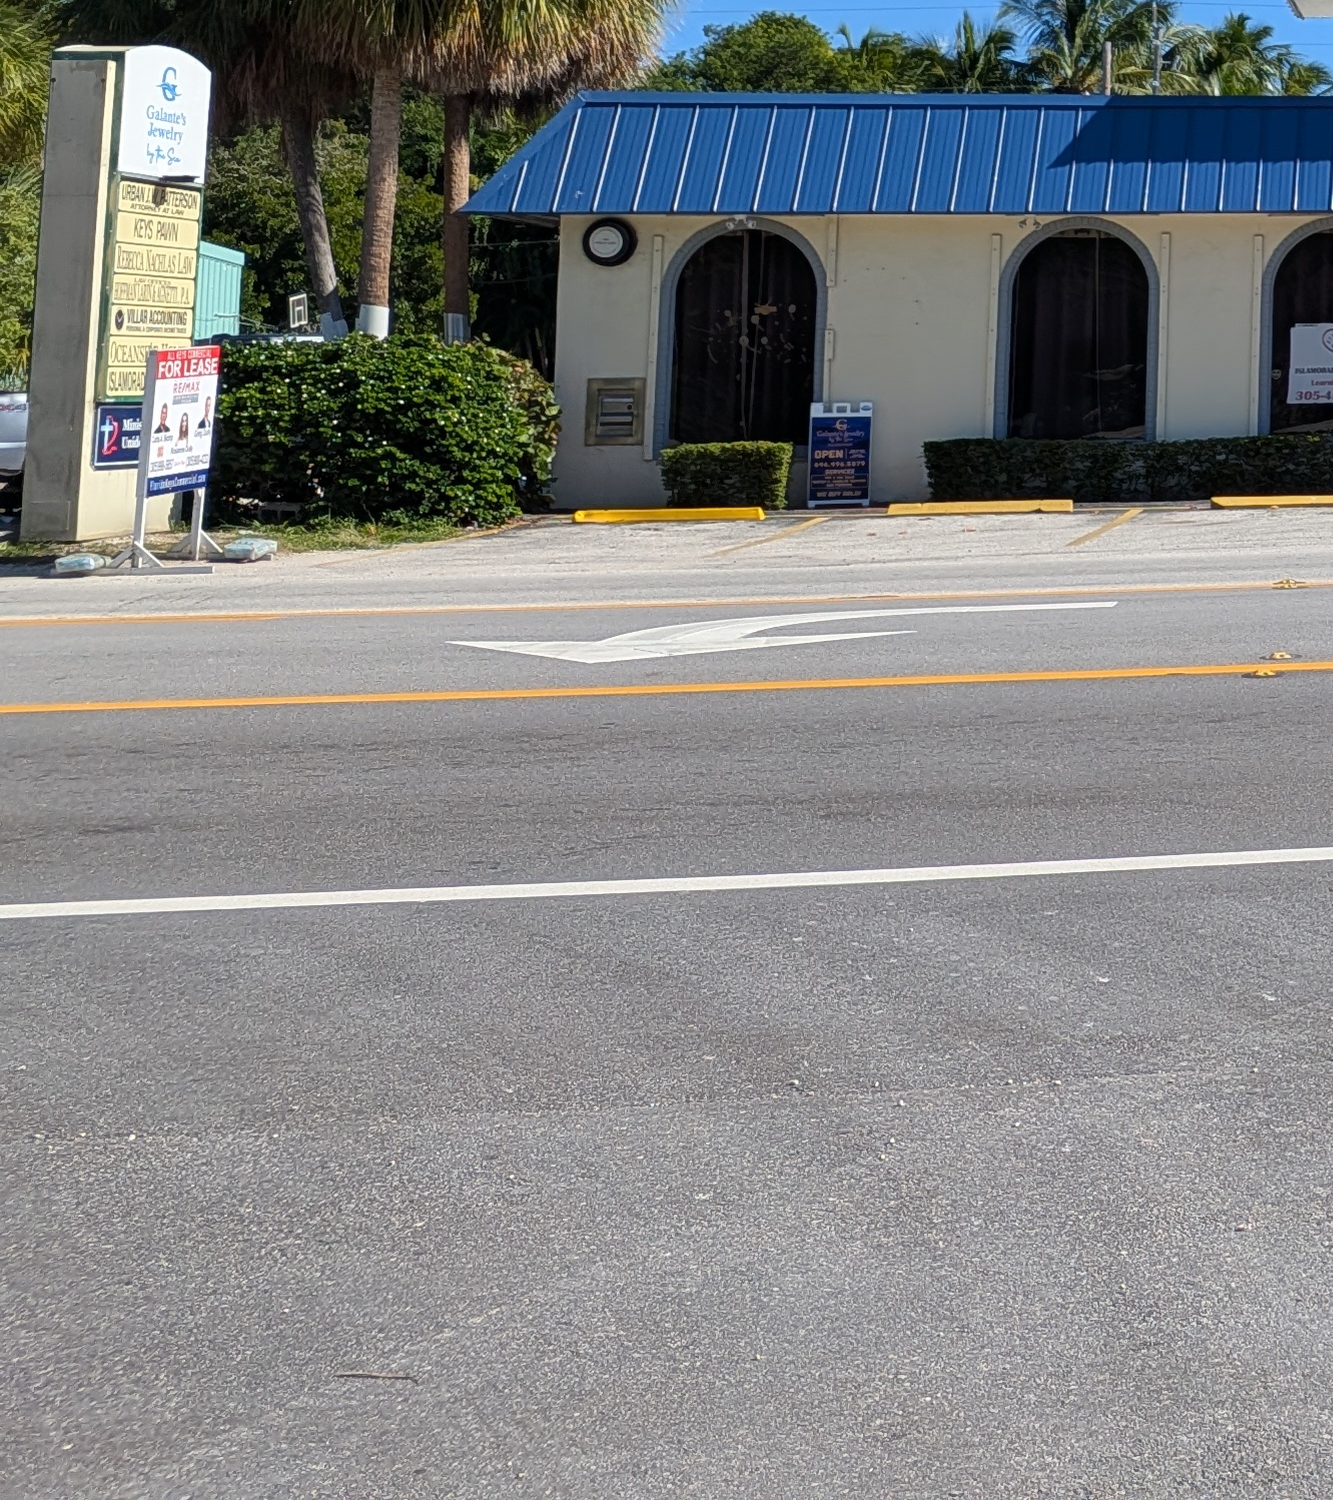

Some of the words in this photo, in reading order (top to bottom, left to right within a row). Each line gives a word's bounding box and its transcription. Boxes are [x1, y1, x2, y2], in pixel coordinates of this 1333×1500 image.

[146, 105, 187, 126] Galante's
[147, 122, 184, 145] Jewelry
[133, 218, 153, 239] KEYS
[156, 220, 179, 242] PAWN
[149, 310, 187, 326] ACCOUNTING
[158, 360, 182, 378] FOR
[183, 358, 219, 377] LEASE
[173, 381, 200, 394] RE/MAX
[814, 450, 844, 459] OPEN
